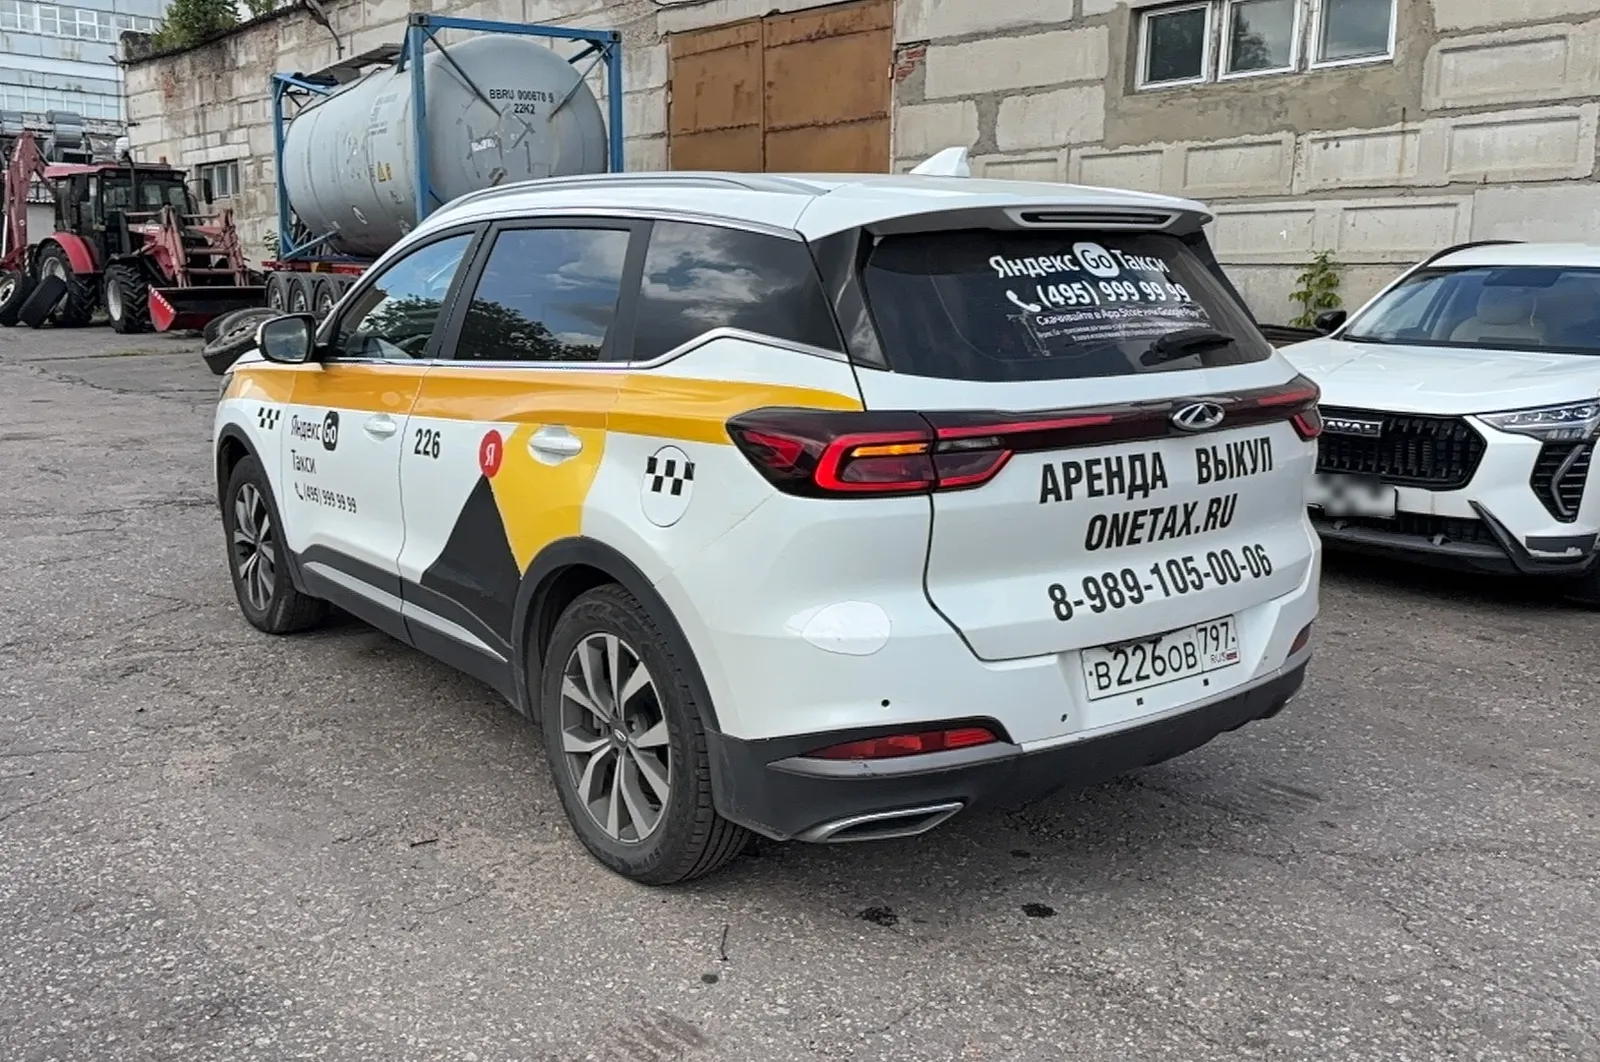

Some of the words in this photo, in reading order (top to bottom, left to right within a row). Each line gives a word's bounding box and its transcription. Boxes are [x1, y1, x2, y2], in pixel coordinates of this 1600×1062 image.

[489, 89, 515, 100] BBRU
[514, 103, 535, 115] 22K2
[989, 253, 1079, 278] Яндекс
[1111, 250, 1170, 274] Такси
[1036, 280, 1101, 307] (495)
[1100, 281, 1140, 302] 999
[1141, 281, 1167, 302] 99
[1167, 283, 1192, 303] 99
[1100, 308, 1120, 319] App
[291, 414, 321, 441] Яндекс
[323, 418, 337, 444] Go
[1320, 420, 1378, 434] AVAL
[413, 428, 441, 459] 226
[484, 442, 494, 467] Я
[291, 449, 317, 474] Такси
[1039, 452, 1169, 504] АРЕНДА
[1196, 437, 1273, 485] ВЫКУП
[1084, 493, 1238, 551] ONETAX.RU
[1048, 543, 1273, 622] 8-989-105-00-06
[1198, 622, 1230, 657] 797
[1210, 651, 1228, 664] RUS
